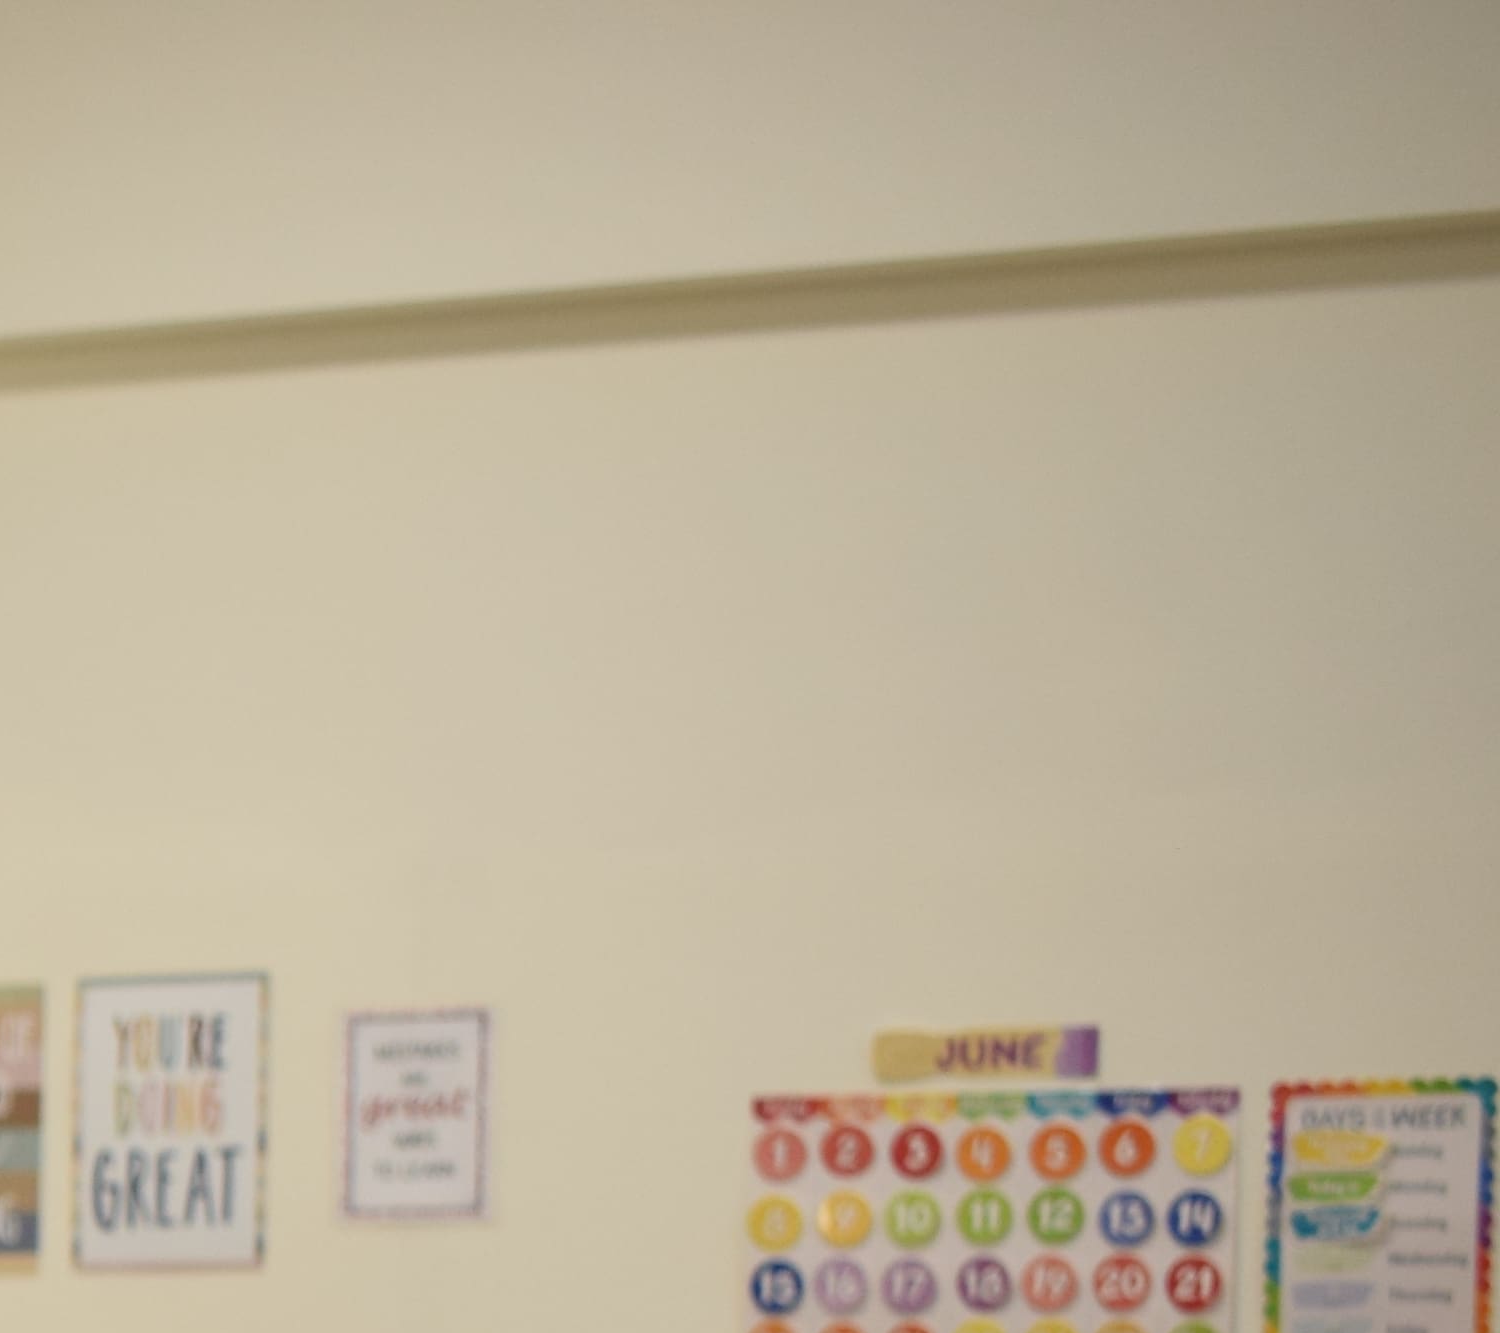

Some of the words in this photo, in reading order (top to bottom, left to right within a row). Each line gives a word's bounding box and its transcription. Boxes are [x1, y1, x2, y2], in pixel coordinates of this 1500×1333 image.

[934, 1033, 1046, 1072] JUNE
[112, 1079, 222, 1137] DOING
[1302, 1108, 1364, 1128] DAYS
[1391, 1105, 1466, 1128] WEEK
[91, 1145, 243, 1231] GREAT
